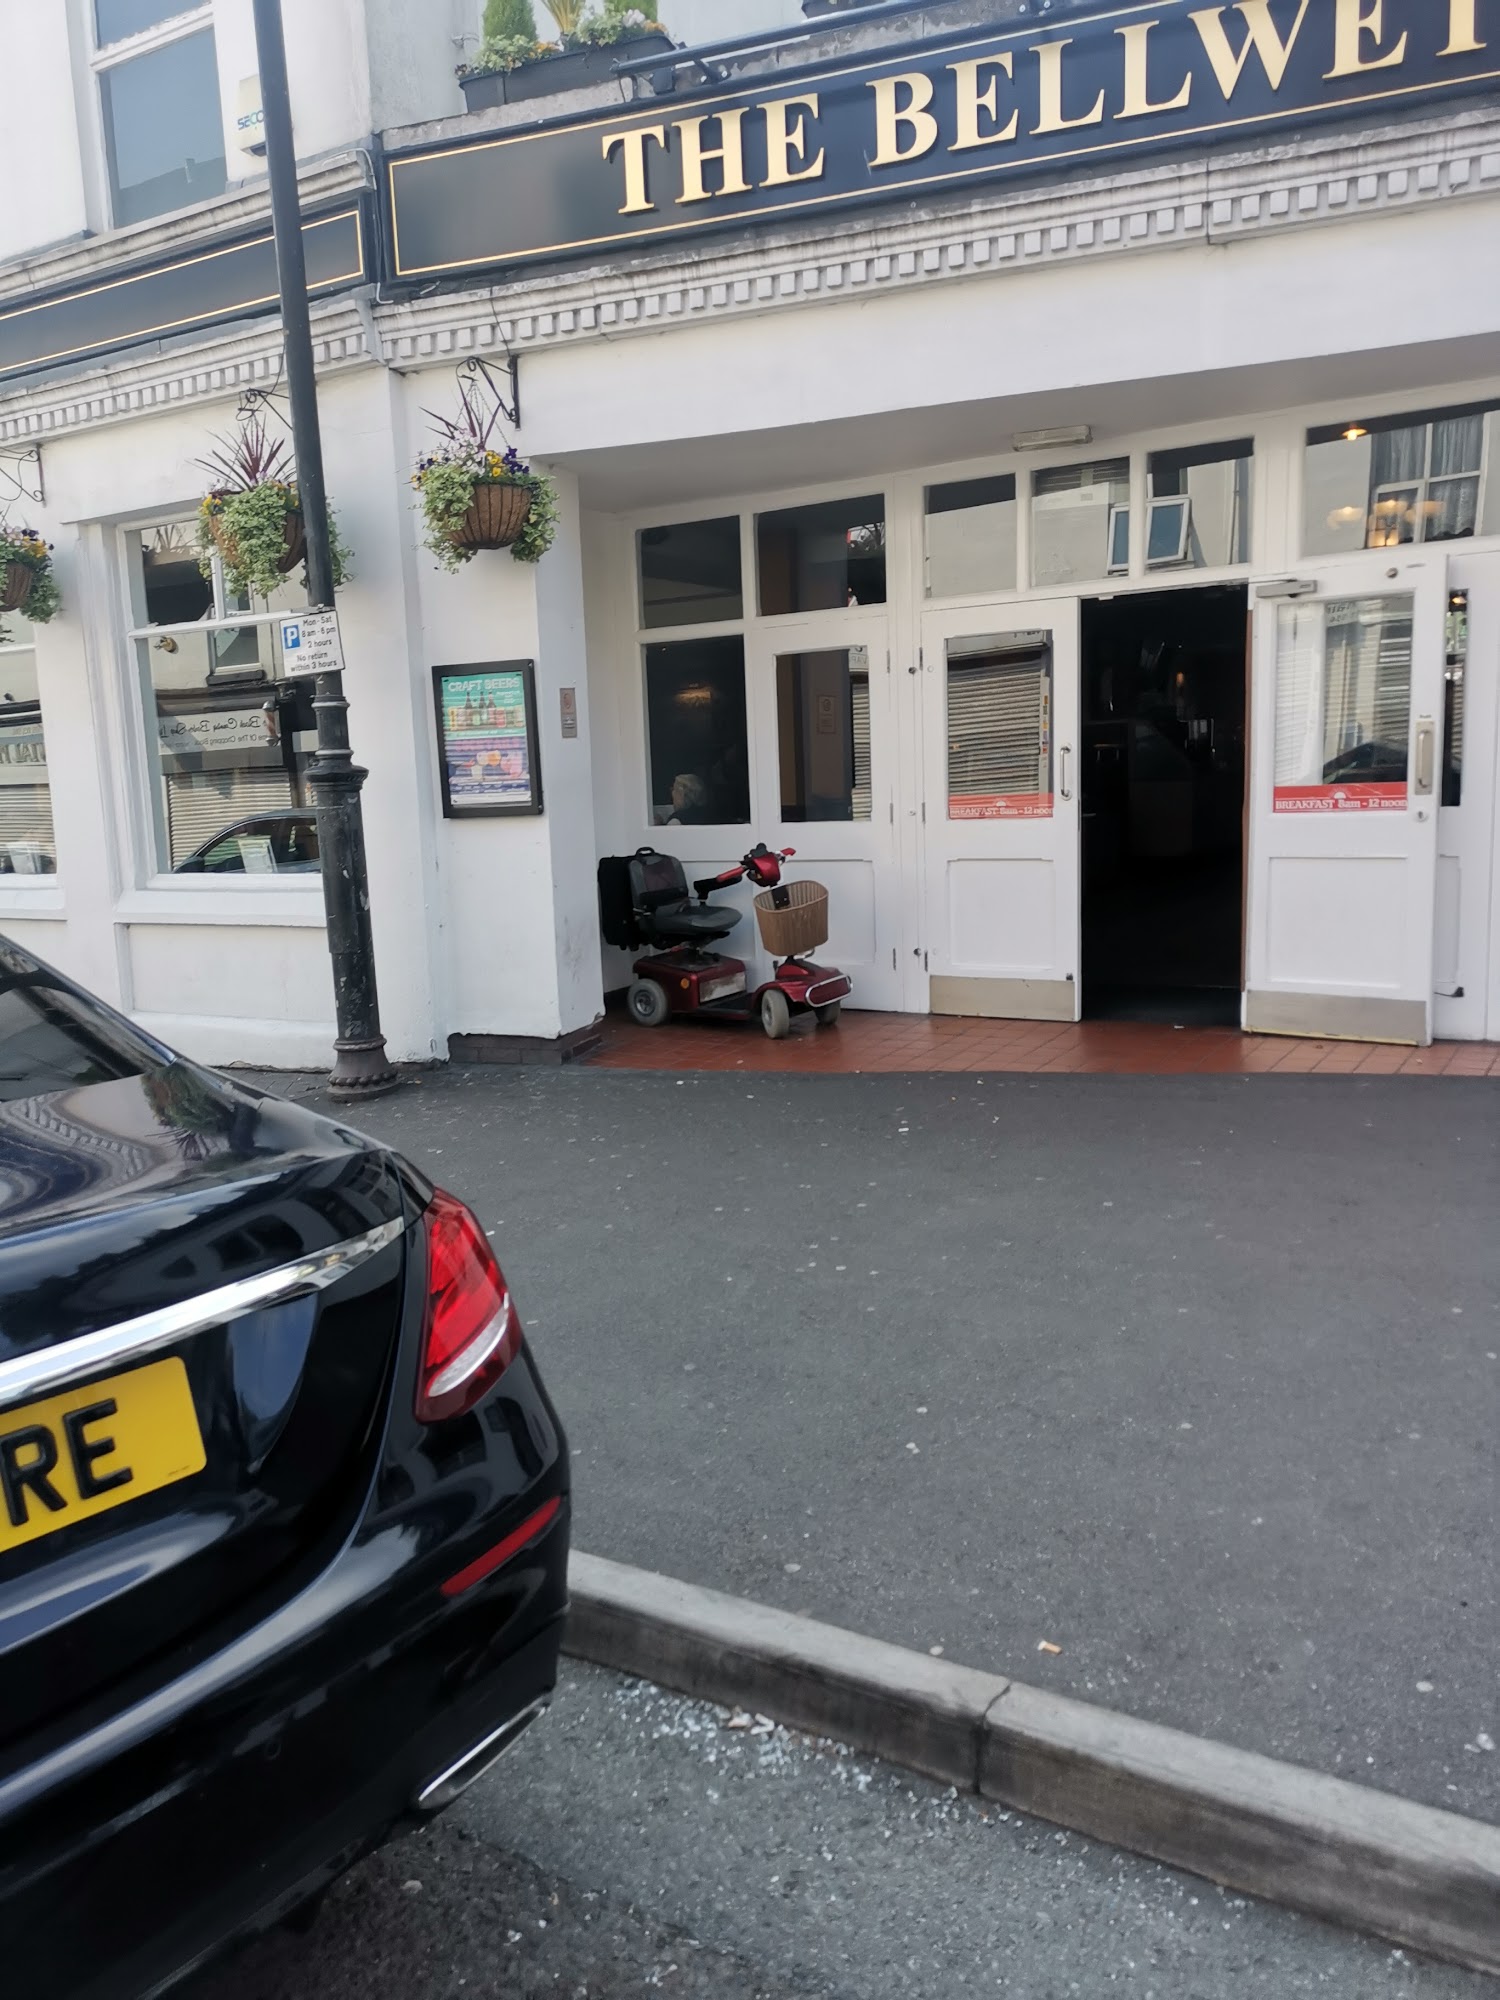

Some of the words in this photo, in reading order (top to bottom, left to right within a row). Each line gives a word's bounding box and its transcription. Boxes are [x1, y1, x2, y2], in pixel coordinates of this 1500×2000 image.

[602, 93, 824, 214] THE
[303, 619, 317, 627] Mon
[321, 616, 332, 624] Sat
[286, 627, 298, 648] P
[314, 639, 333, 647] hours
[297, 654, 307, 662] No
[308, 652, 329, 660] return
[291, 663, 311, 672] within
[318, 660, 338, 668] hours
[448, 680, 482, 692] CRAFT
[485, 677, 520, 689] BEERS
[1275, 799, 1335, 810] BREAKFAST
[1337, 799, 1361, 808] 8am
[1368, 798, 1379, 807] 12
[1380, 798, 1408, 808] noon
[950, 807, 998, 816] BREAKFAST
[1023, 806, 1033, 815] 12
[0, 1397, 133, 1527] RE
